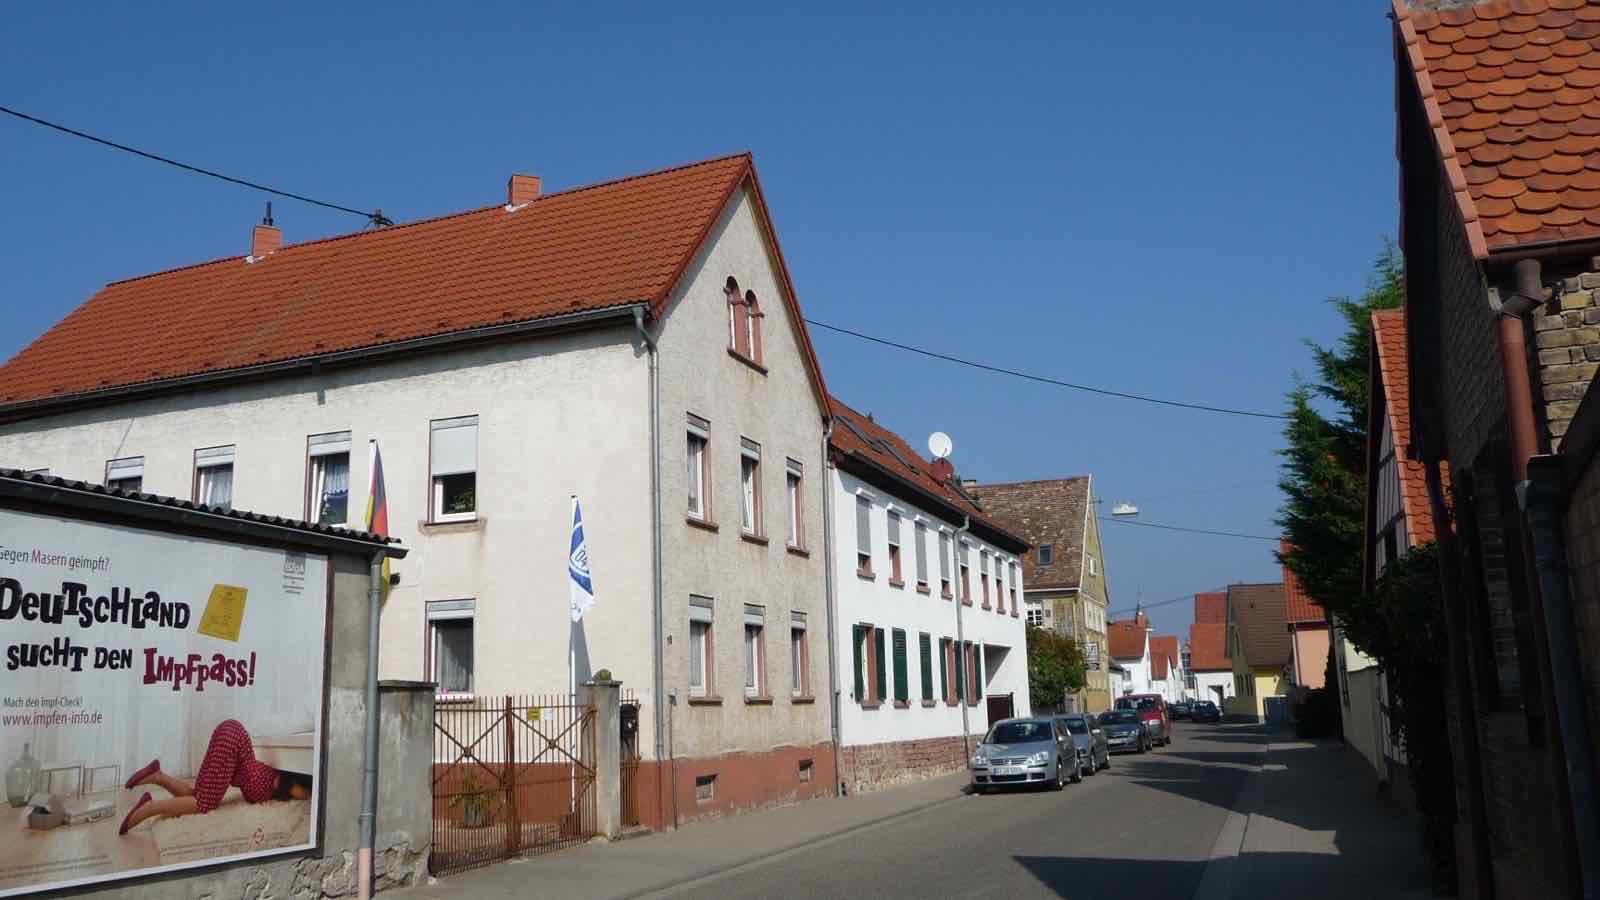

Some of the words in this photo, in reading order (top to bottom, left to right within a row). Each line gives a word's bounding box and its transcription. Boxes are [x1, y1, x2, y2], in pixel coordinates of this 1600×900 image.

[31, 549, 67, 567] Masern
[68, 555, 110, 572] geimpft?
[25, 697, 40, 708] den
[2, 710, 103, 728] www.impfen-info.de
